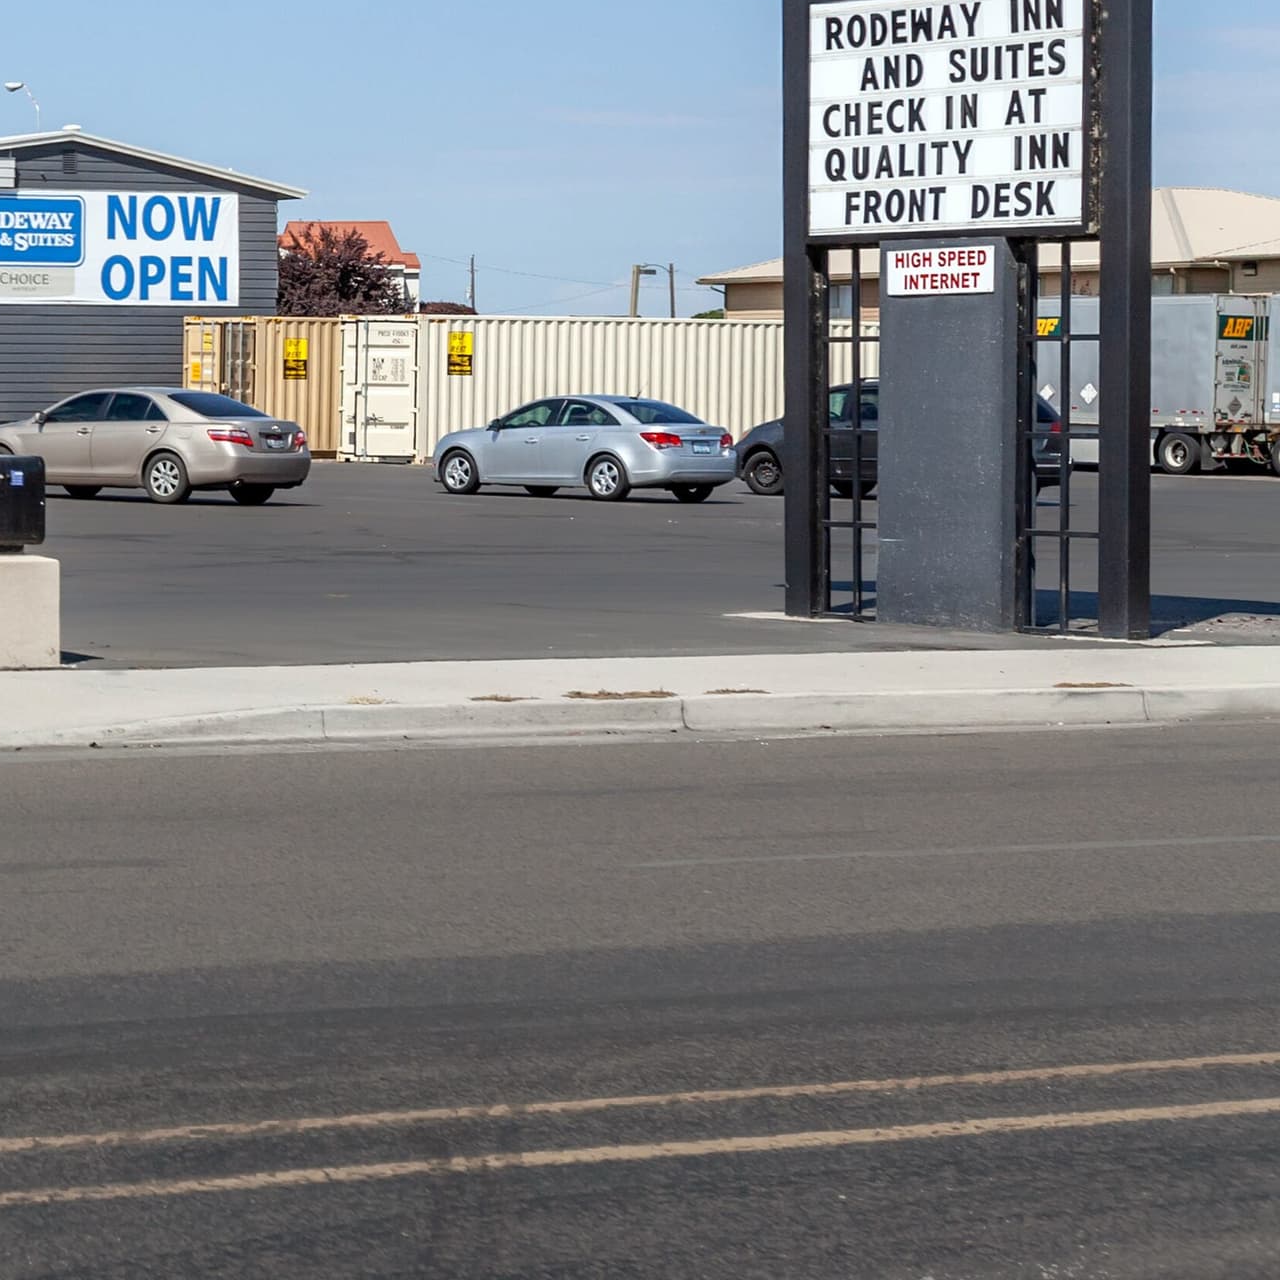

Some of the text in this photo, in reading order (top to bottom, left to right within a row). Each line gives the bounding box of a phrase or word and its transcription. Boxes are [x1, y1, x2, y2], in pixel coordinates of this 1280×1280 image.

[825, 2, 981, 50] RODEWAY
[860, 39, 1066, 91] AND SUITES
[822, 88, 1046, 137] CHECK IN AT
[825, 132, 1070, 182] QUALITY INN
[106, 194, 221, 241] NOW
[845, 181, 1055, 225] FRONT DESK
[0, 232, 12, 246] &
[14, 233, 74, 251] SUITES
[895, 249, 987, 268] HIGH SPEED
[0, 272, 49, 285] CHOICE
[101, 255, 228, 301] OPEN
[904, 272, 980, 290] INTERNET
[1036, 318, 1059, 336] BF
